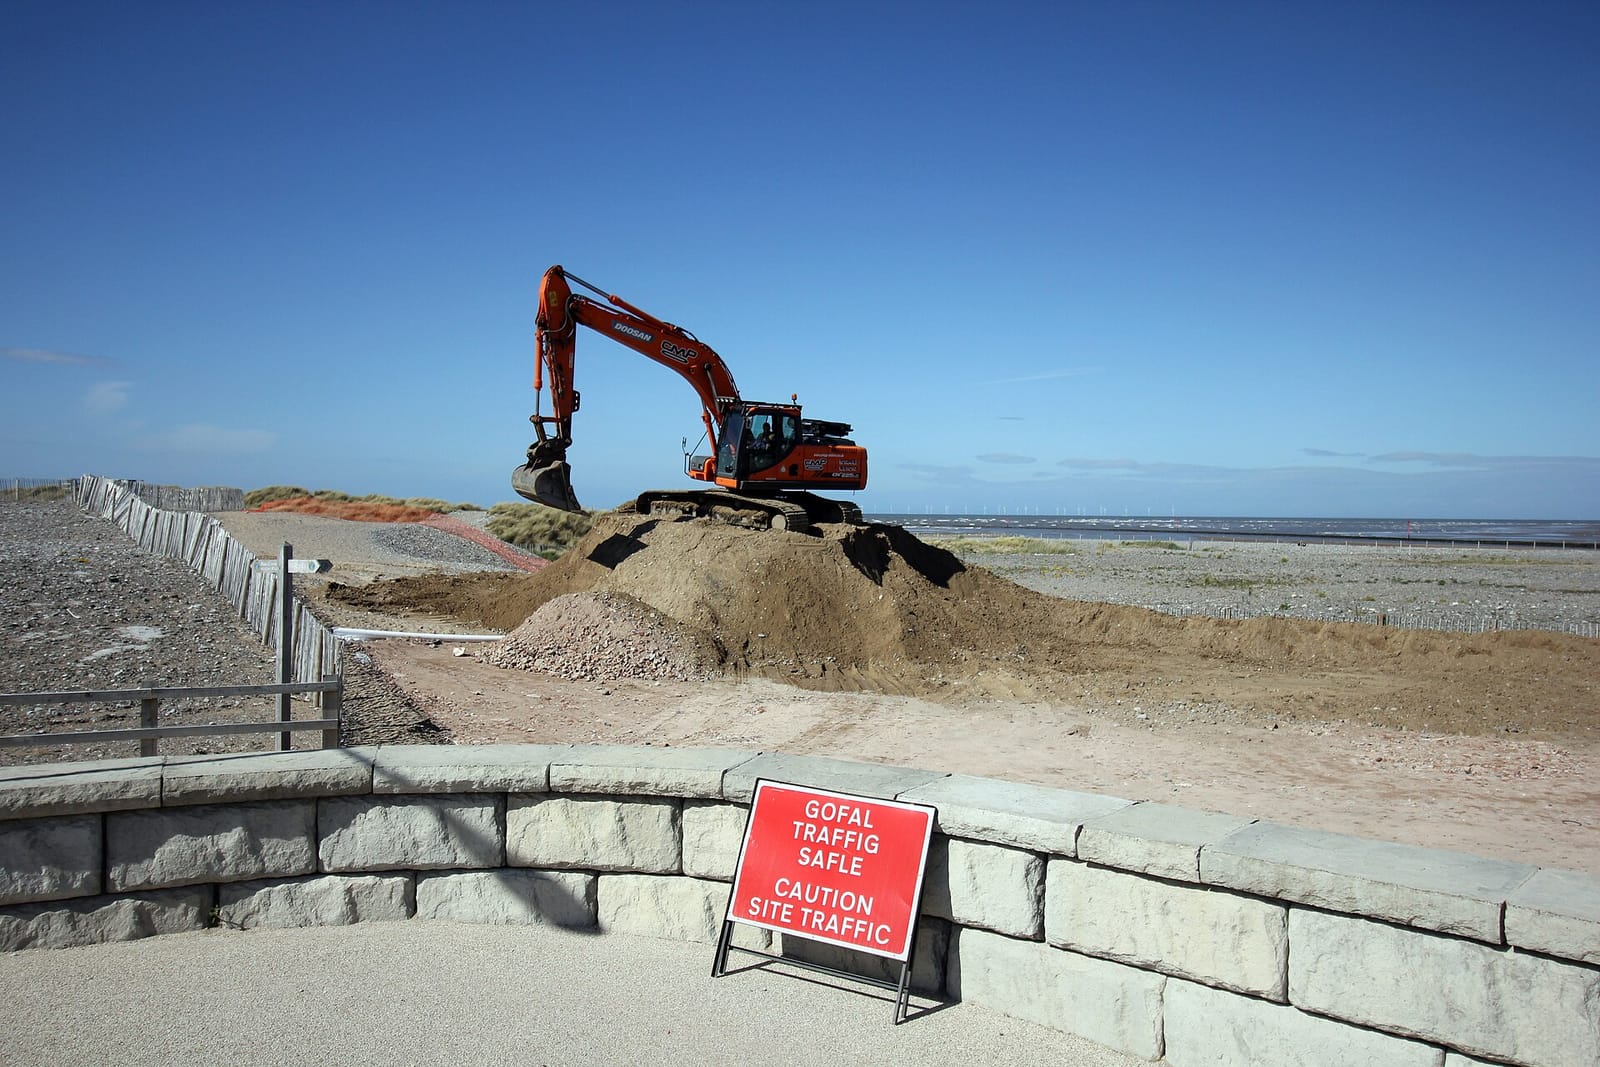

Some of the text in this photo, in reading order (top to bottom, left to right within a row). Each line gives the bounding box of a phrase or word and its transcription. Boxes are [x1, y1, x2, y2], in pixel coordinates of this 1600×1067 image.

[614, 322, 652, 342] DOOSAN
[661, 340, 698, 359] CMP
[805, 800, 874, 828] GOFAL
[792, 821, 880, 854] TRAFFIG
[798, 847, 864, 876] SAFLE
[774, 877, 874, 916] CAUTION
[748, 897, 892, 945] SITE TRAFFIC
